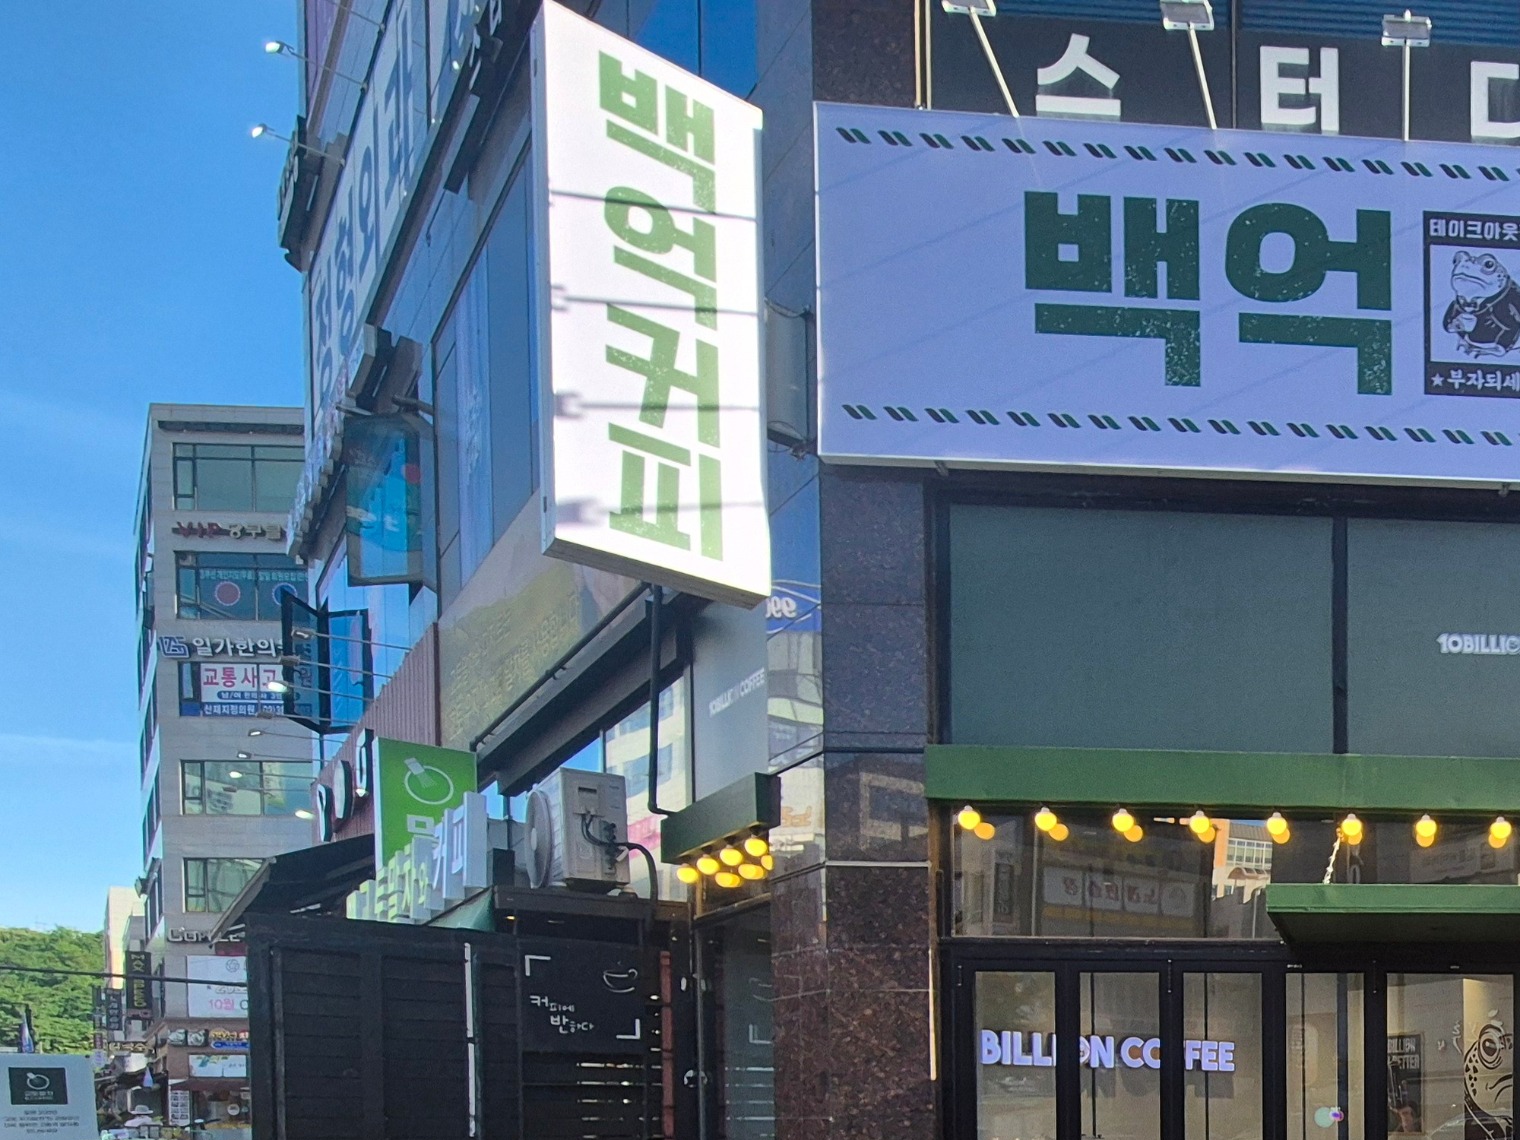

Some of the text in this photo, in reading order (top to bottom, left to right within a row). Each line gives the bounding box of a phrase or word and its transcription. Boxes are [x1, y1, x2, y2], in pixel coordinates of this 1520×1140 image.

[1024, 191, 1392, 395] 백억
[597, 50, 725, 562] 백억커피
[192, 636, 283, 658] 일가한의
[203, 666, 277, 689] 교통사고
[529, 996, 575, 1013] 커피에
[550, 1015, 594, 1034] 반하다
[980, 1029, 1236, 1072] BILLN COFEE
